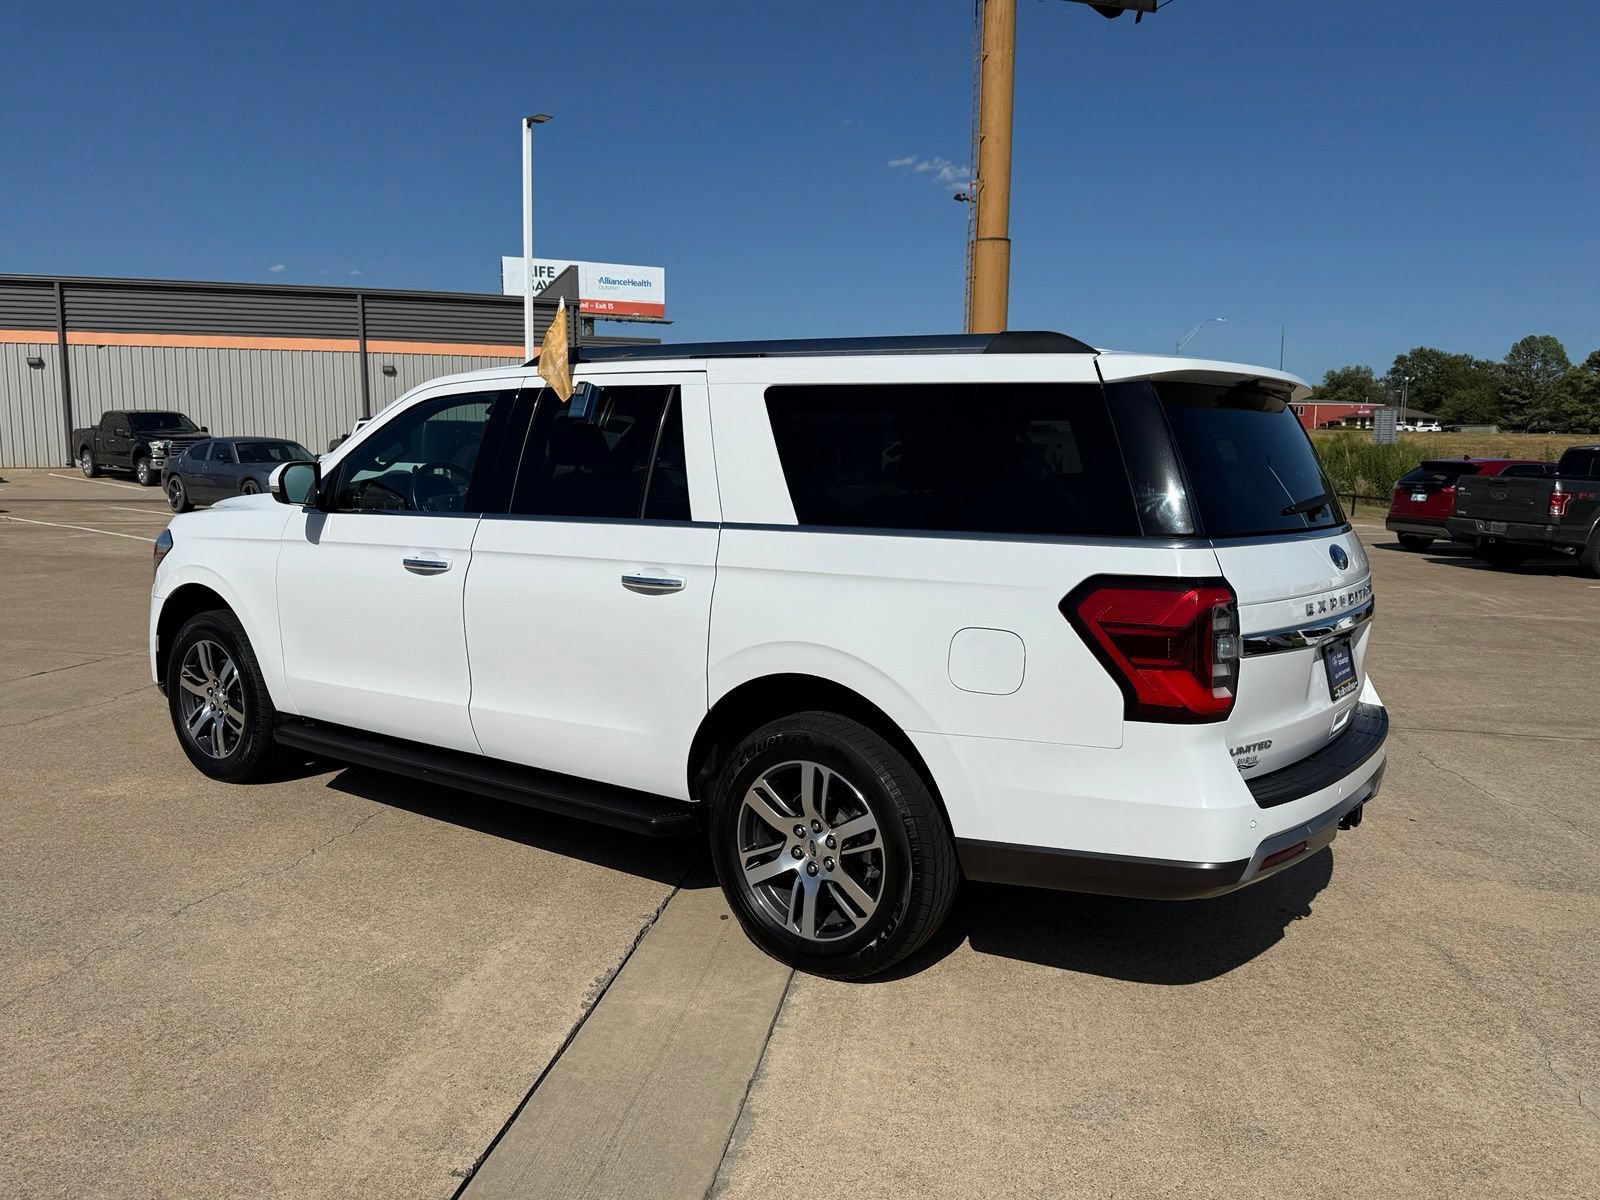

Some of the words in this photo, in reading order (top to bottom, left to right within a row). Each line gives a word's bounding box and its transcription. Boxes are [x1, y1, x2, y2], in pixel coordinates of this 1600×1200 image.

[532, 265, 555, 278] IFE
[532, 279, 553, 291] AV
[598, 276, 652, 288] AllianceHealth
[1229, 739, 1273, 757] LIMITED
